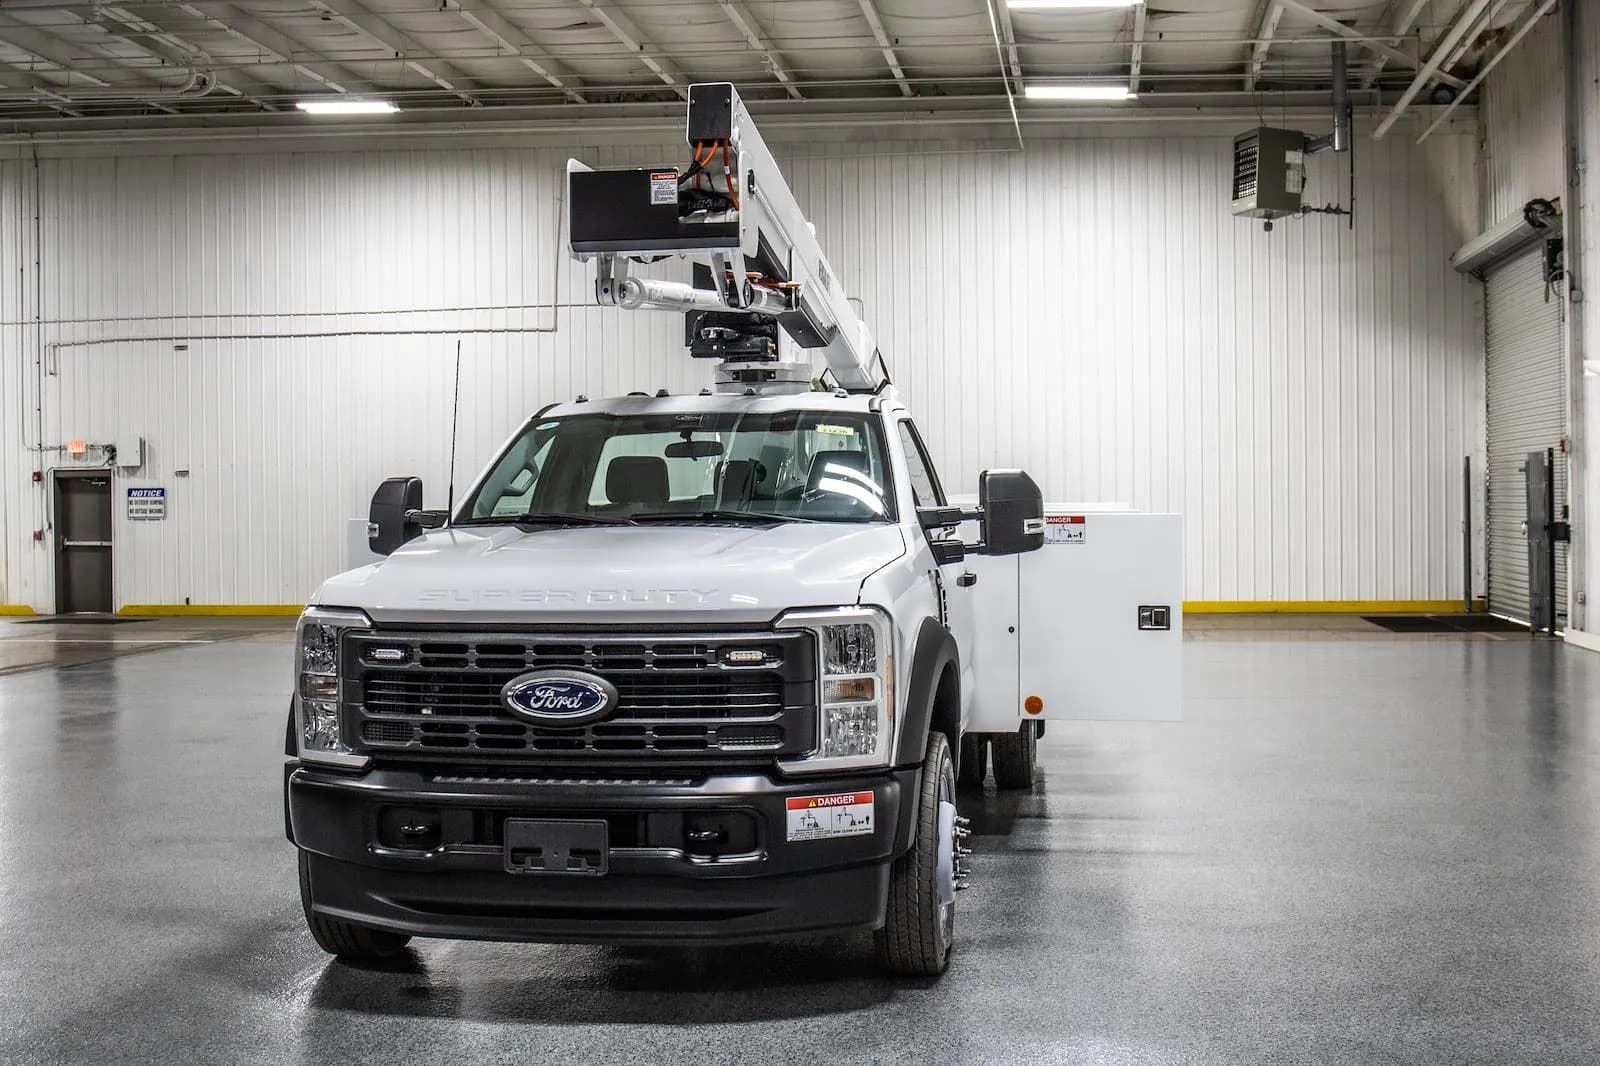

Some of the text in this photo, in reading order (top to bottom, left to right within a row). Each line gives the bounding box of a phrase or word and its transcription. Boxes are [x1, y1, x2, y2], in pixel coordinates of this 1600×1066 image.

[419, 588, 720, 602] SUPER DUTY
[530, 685, 584, 708] Ford
[818, 795, 855, 806] DANGER
